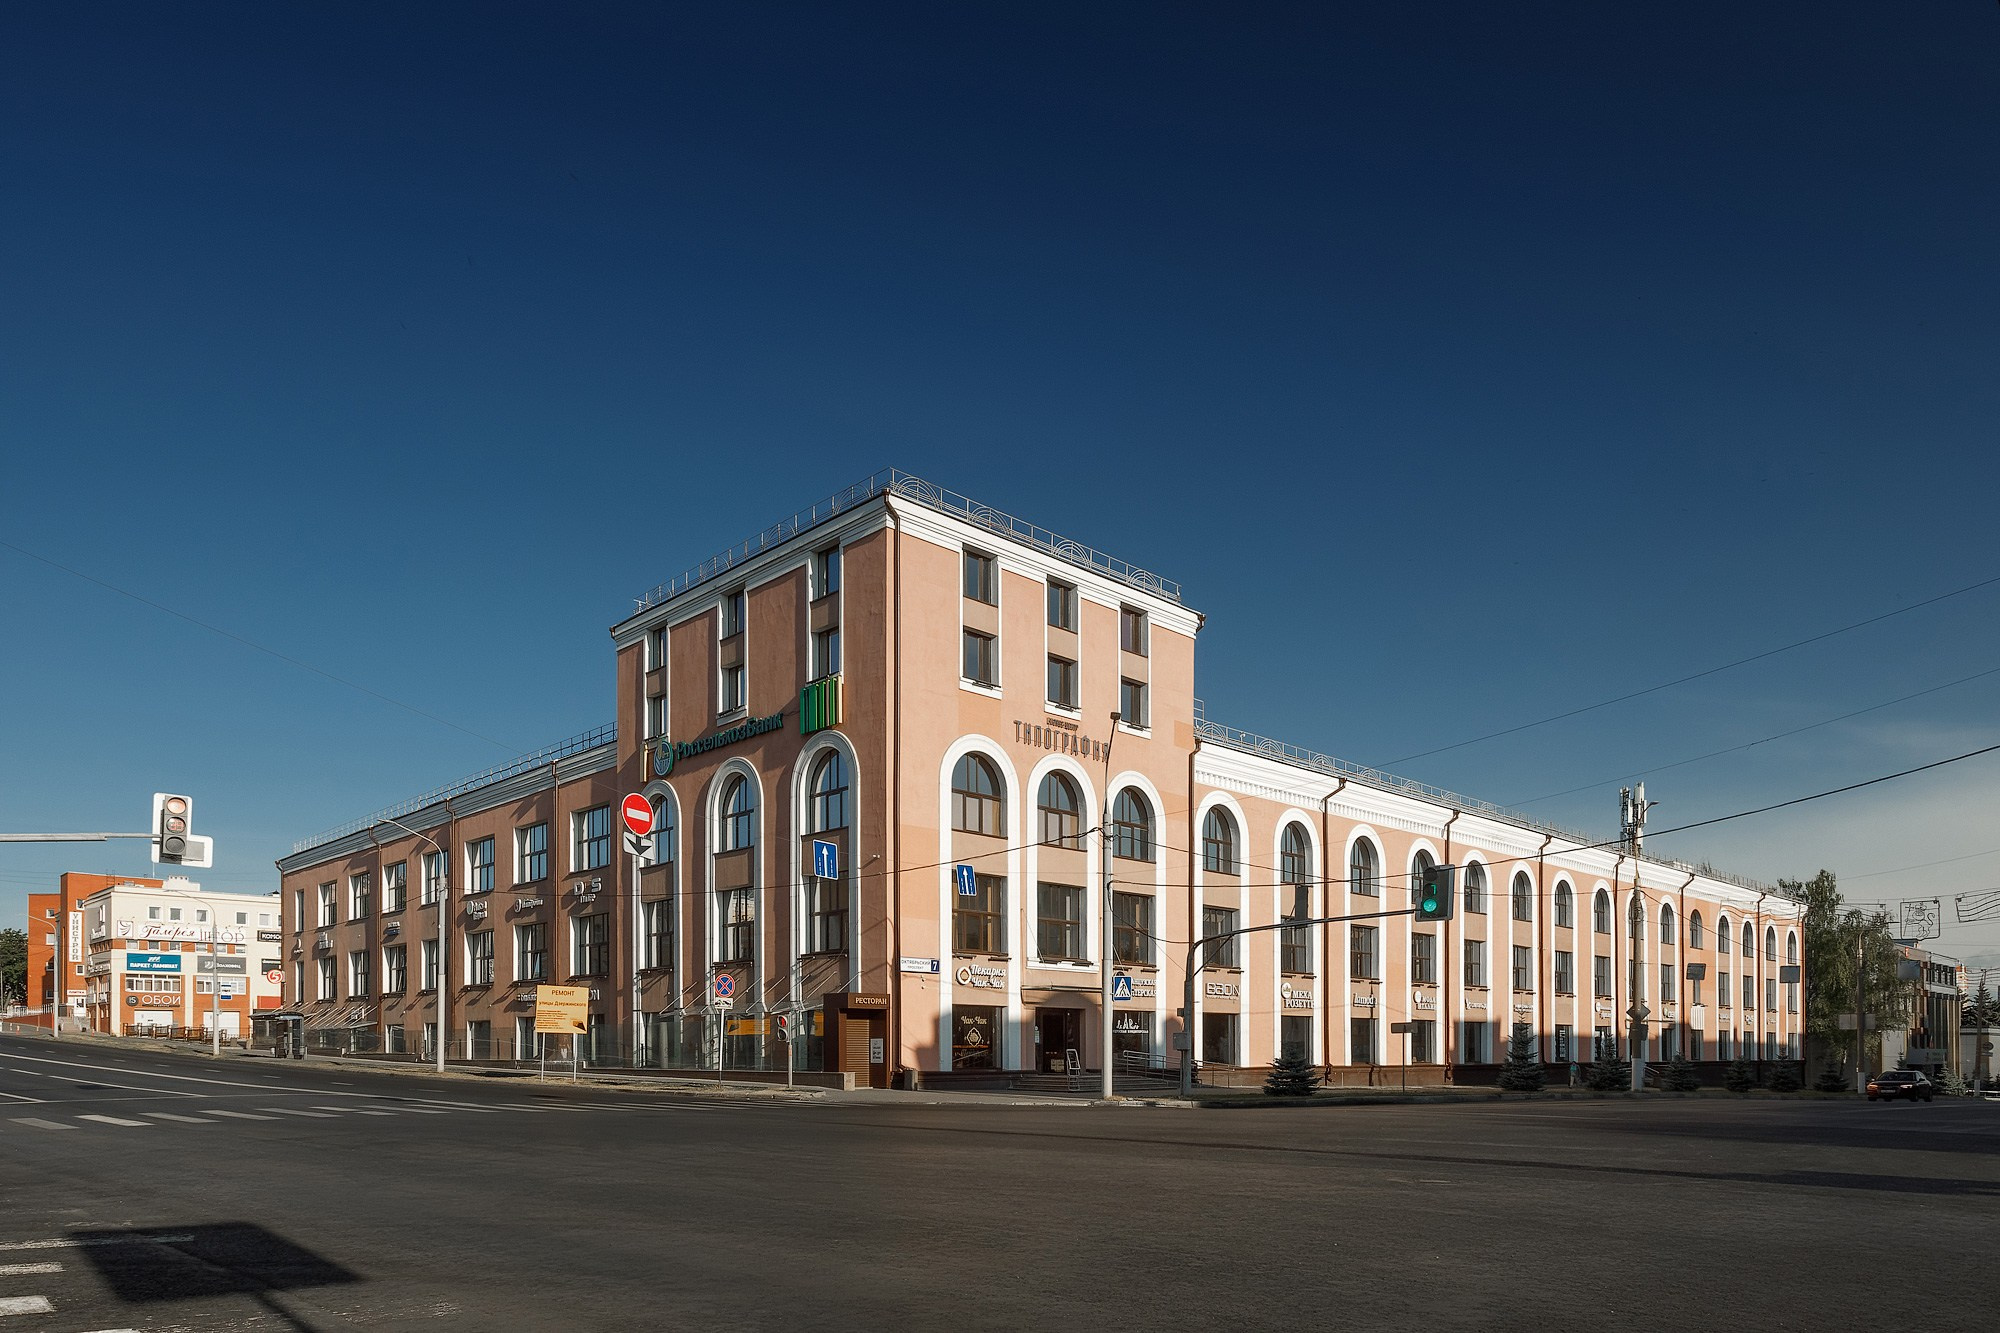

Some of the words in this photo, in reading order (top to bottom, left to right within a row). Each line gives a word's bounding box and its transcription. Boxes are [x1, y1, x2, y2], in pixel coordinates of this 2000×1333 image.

[676, 712, 783, 761] РоссельхозБанк
[1013, 719, 1109, 763] ТИПОГРАФИЯ
[142, 925, 195, 940] Галерея
[261, 932, 282, 940] КОМО
[932, 960, 938, 971] 7
[970, 964, 1006, 978] Пекарня
[142, 995, 180, 1005] ОБОИ
